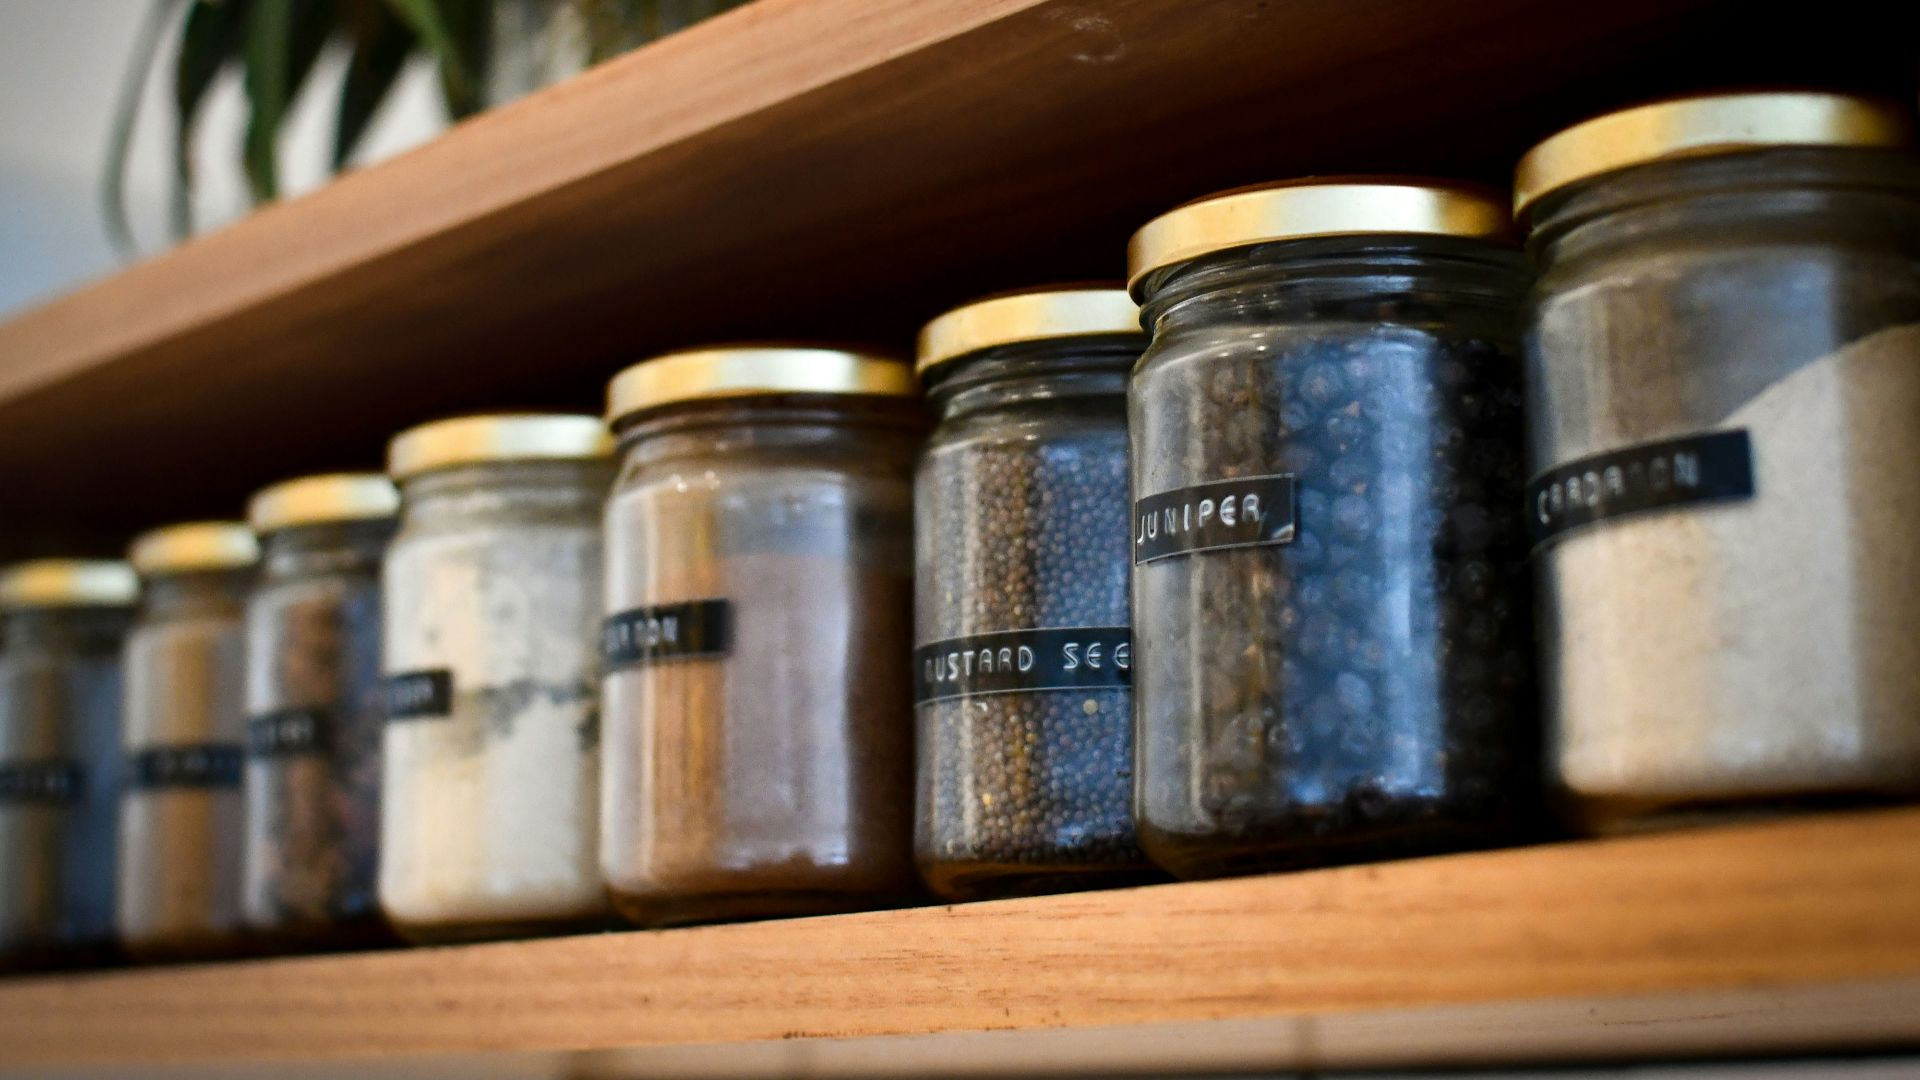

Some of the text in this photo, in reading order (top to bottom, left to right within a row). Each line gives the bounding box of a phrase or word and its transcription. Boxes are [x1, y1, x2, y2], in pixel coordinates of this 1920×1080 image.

[1537, 452, 1699, 525] CARDAON
[1136, 493, 1260, 545] JUNIPER
[1063, 642, 1129, 669] SEE
